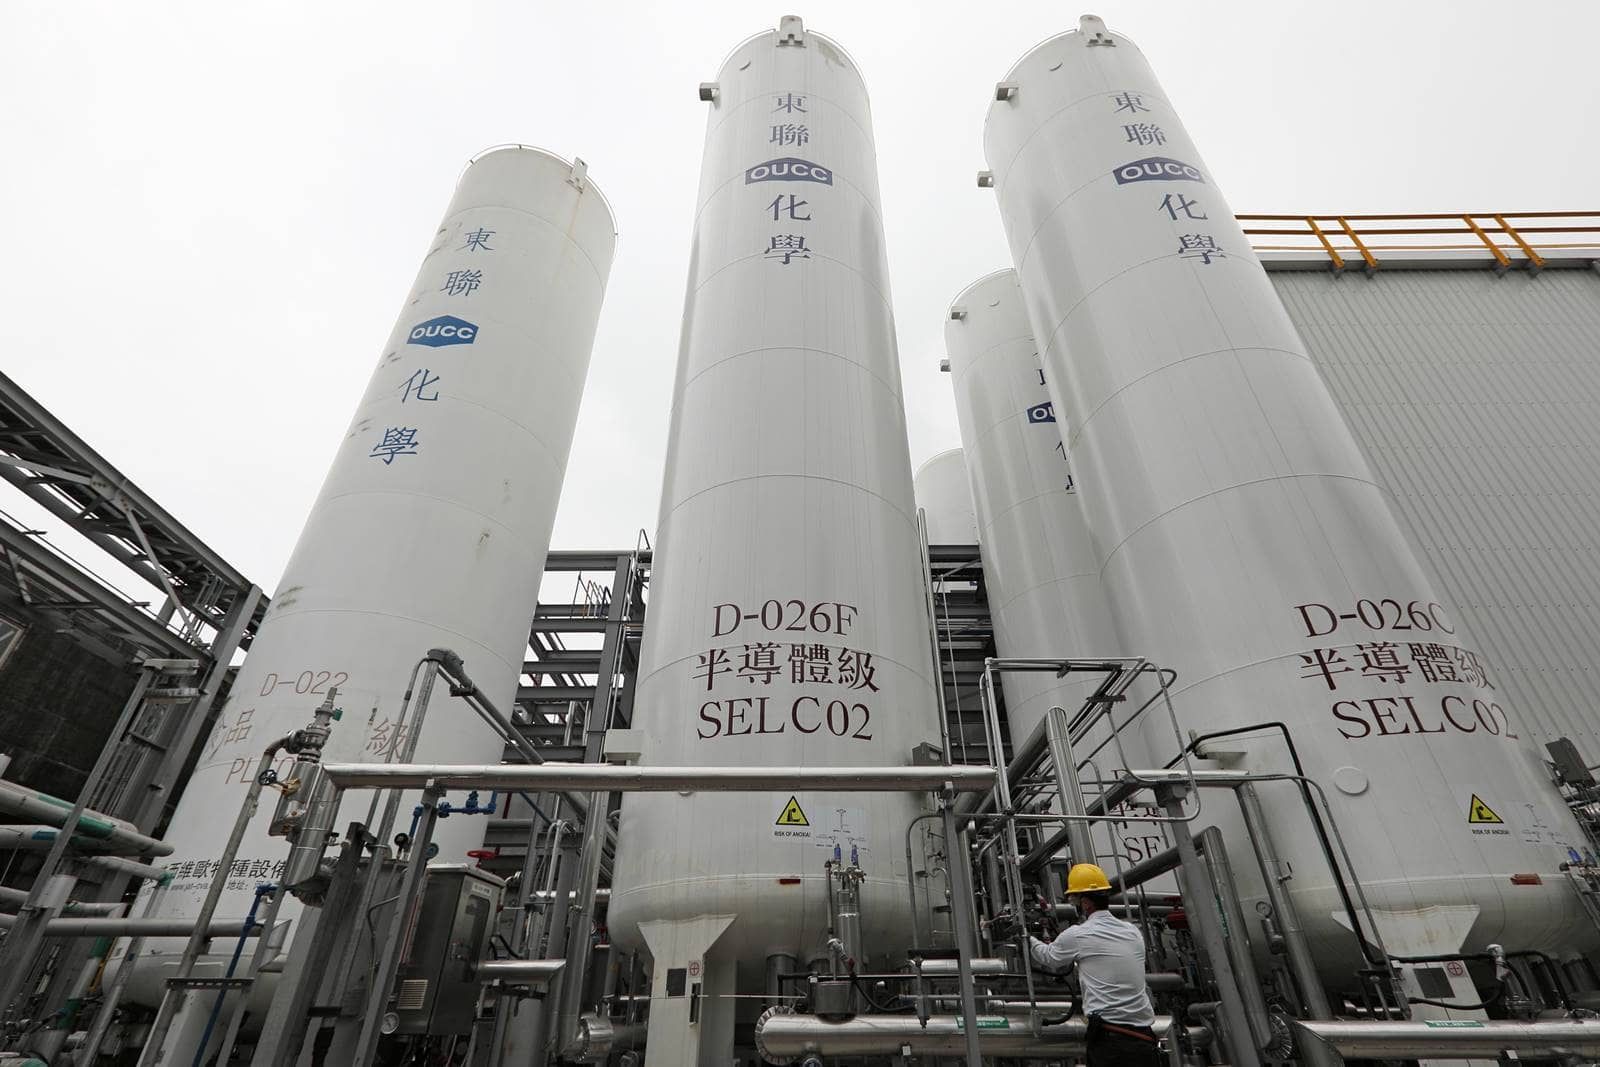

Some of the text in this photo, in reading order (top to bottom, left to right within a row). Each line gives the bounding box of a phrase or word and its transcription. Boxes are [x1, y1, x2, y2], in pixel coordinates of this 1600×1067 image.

[769, 93, 809, 146] 東聯
[1108, 92, 1167, 146] 東聯
[750, 162, 828, 181] OUCC
[1120, 162, 1200, 180] OUCC
[764, 194, 812, 265] 化學
[1158, 193, 1226, 265] 化學
[440, 227, 496, 297] 東聯
[410, 325, 474, 340] OUCC
[369, 368, 440, 466] 化學
[711, 599, 858, 638] D-026F
[260, 670, 348, 697] D-022
[692, 641, 880, 693] 半導體級
[1299, 641, 1495, 691] 半導體級
